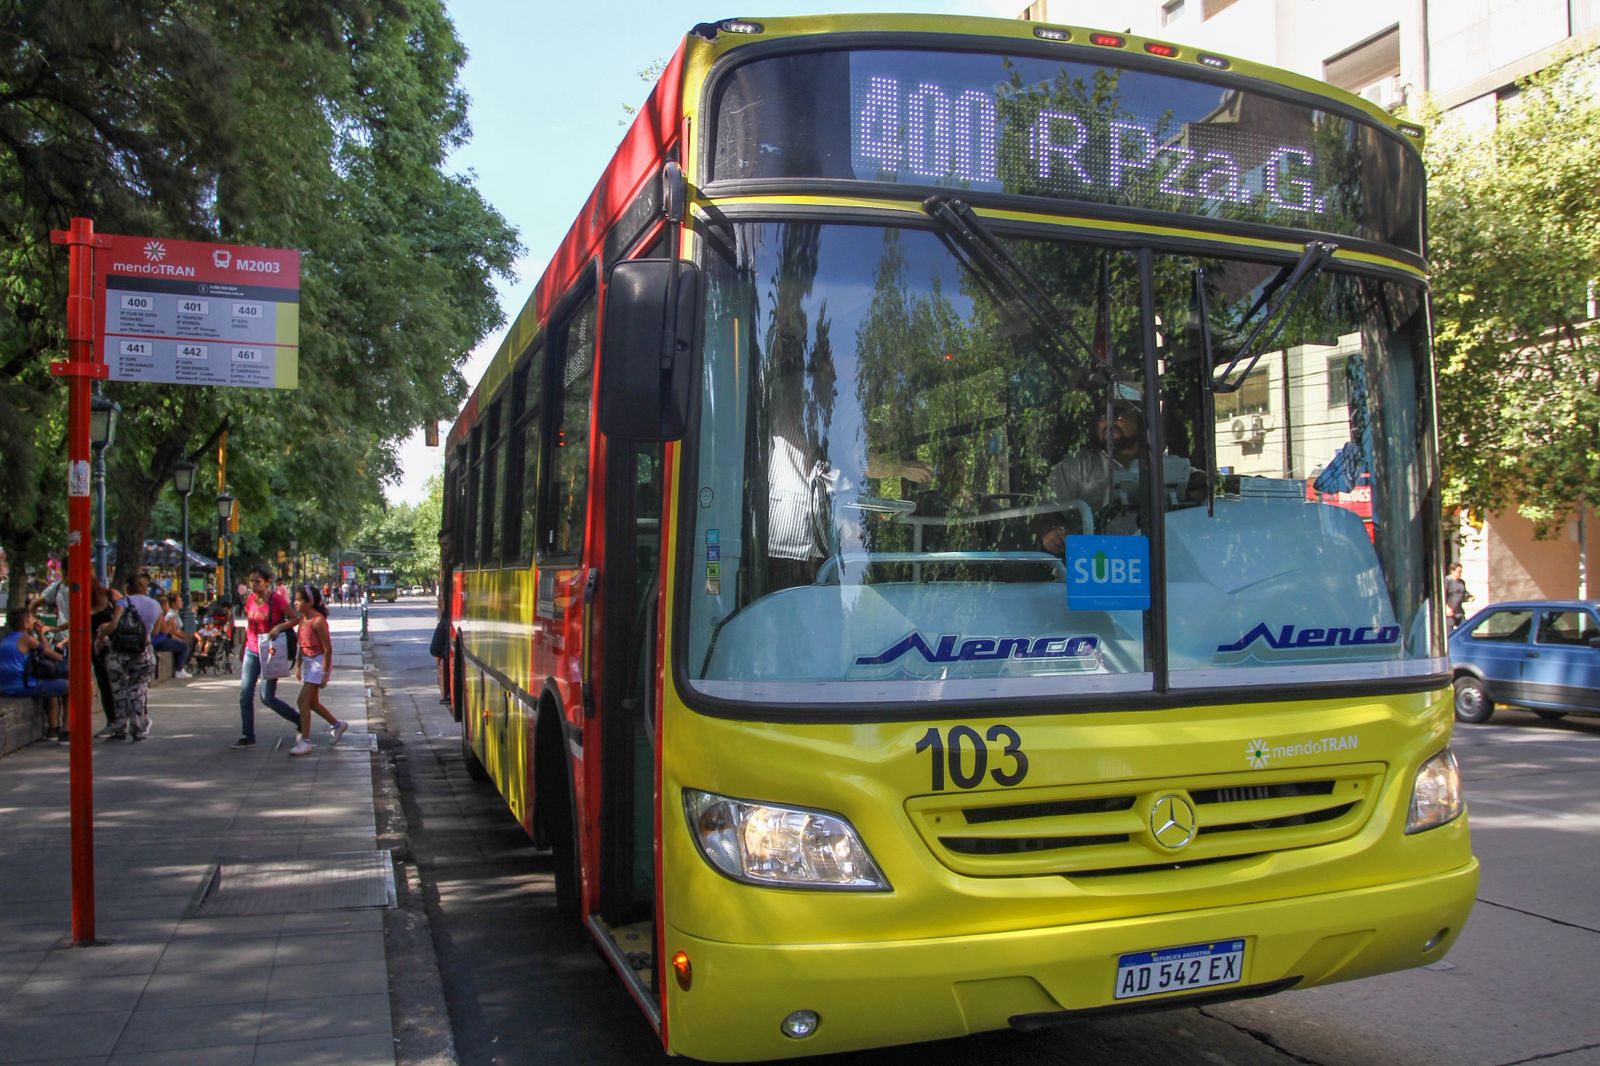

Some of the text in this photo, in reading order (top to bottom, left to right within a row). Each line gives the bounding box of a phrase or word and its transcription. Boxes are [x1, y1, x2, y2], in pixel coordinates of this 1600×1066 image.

[860, 76, 996, 183] 400
[1109, 119, 1251, 205] Pza.
[1266, 144, 1325, 214] G.
[113, 261, 195, 277] mendoTRAN
[236, 258, 281, 274] M2003
[127, 297, 148, 308] 400
[183, 302, 202, 312] 401
[238, 305, 257, 317] 440
[126, 342, 145, 354] 441
[182, 346, 202, 357] 442
[237, 350, 255, 361] 461
[1074, 558, 1142, 584] SUBE
[1217, 621, 1401, 652] Alenco
[855, 631, 1099, 664] Alenco
[1272, 734, 1358, 759] mendoTRAN
[914, 724, 1029, 791] 103
[1121, 954, 1237, 994] AD 542 EX
